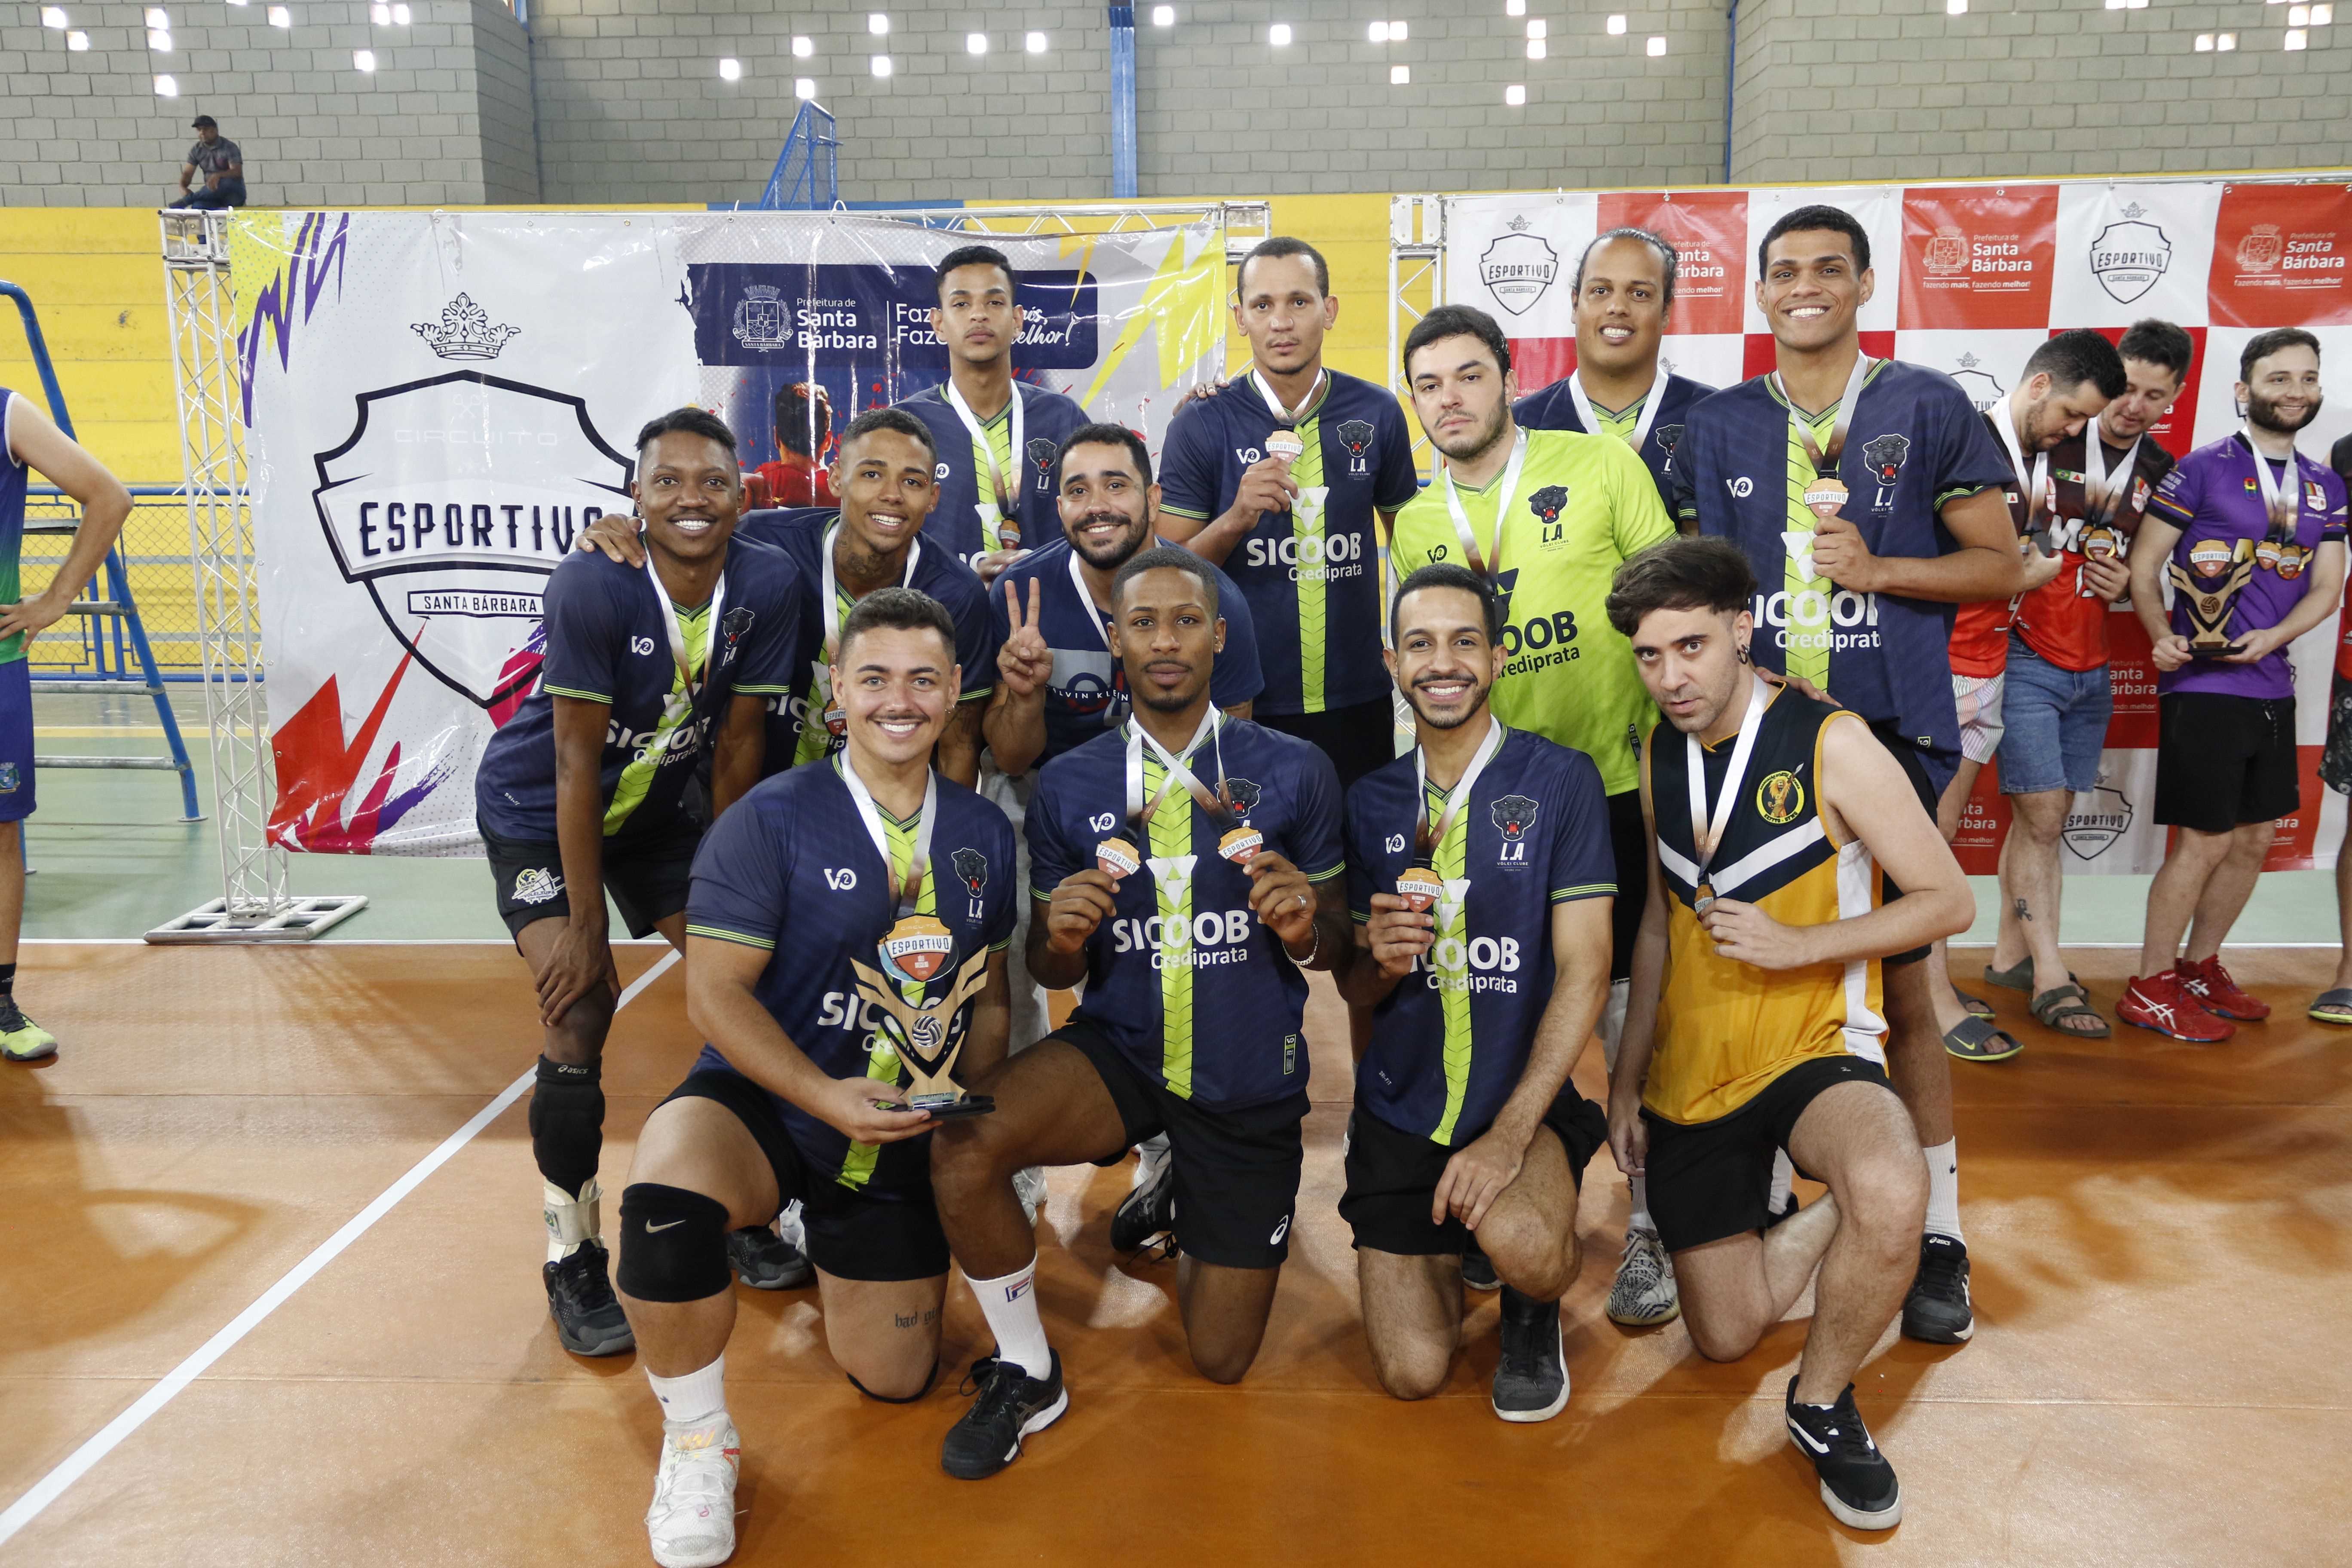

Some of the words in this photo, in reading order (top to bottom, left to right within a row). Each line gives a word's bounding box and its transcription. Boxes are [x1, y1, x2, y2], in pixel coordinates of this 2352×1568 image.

[1973, 243, 2018, 256] Santa
[2285, 241, 2333, 253] Santa
[1676, 249, 1710, 261] anta
[2098, 253, 2162, 267] ESPORTIVO
[2282, 254, 2345, 270] Bárbara
[1489, 265, 1549, 279] ESPORTIVO
[1677, 264, 1724, 278] árbara
[1972, 258, 2032, 272] Bárbara
[797, 298, 843, 307] Prefeitura
[845, 298, 856, 307] de
[797, 309, 857, 327] Santa
[798, 330, 877, 349] Bárbara
[1012, 318, 1075, 346] elhor!
[395, 429, 558, 446] CIRCUITO
[1268, 443, 1301, 453] ESPORTIVO
[1664, 458, 1672, 472] L
[1807, 493, 1846, 502] ESPORTIVO
[1543, 524, 1562, 543] LA
[1247, 533, 1362, 567] SICOOB
[1289, 563, 1362, 582] Crediprata
[424, 595, 468, 610] SANTA
[473, 595, 537, 612] BÁRBARA
[1499, 646, 1580, 679] rediprata
[2110, 668, 2144, 680] anta
[1097, 689, 1128, 701] KLEIN
[2110, 682, 2157, 695] árbara
[1958, 817, 1997, 829] rbara
[2064, 815, 2123, 827] SPORTIVO
[1223, 835, 1262, 857] ESPORTIVO
[1098, 847, 1136, 873] ESPORTIVO
[1400, 882, 1440, 896] ESPORTIVO
[1112, 910, 1250, 953] SICOOB
[892, 937, 949, 955] ESPORTIVO
[1152, 947, 1248, 969] Crediprata
[1427, 973, 1517, 994] Crediprata
[895, 1311, 917, 1328] bad
